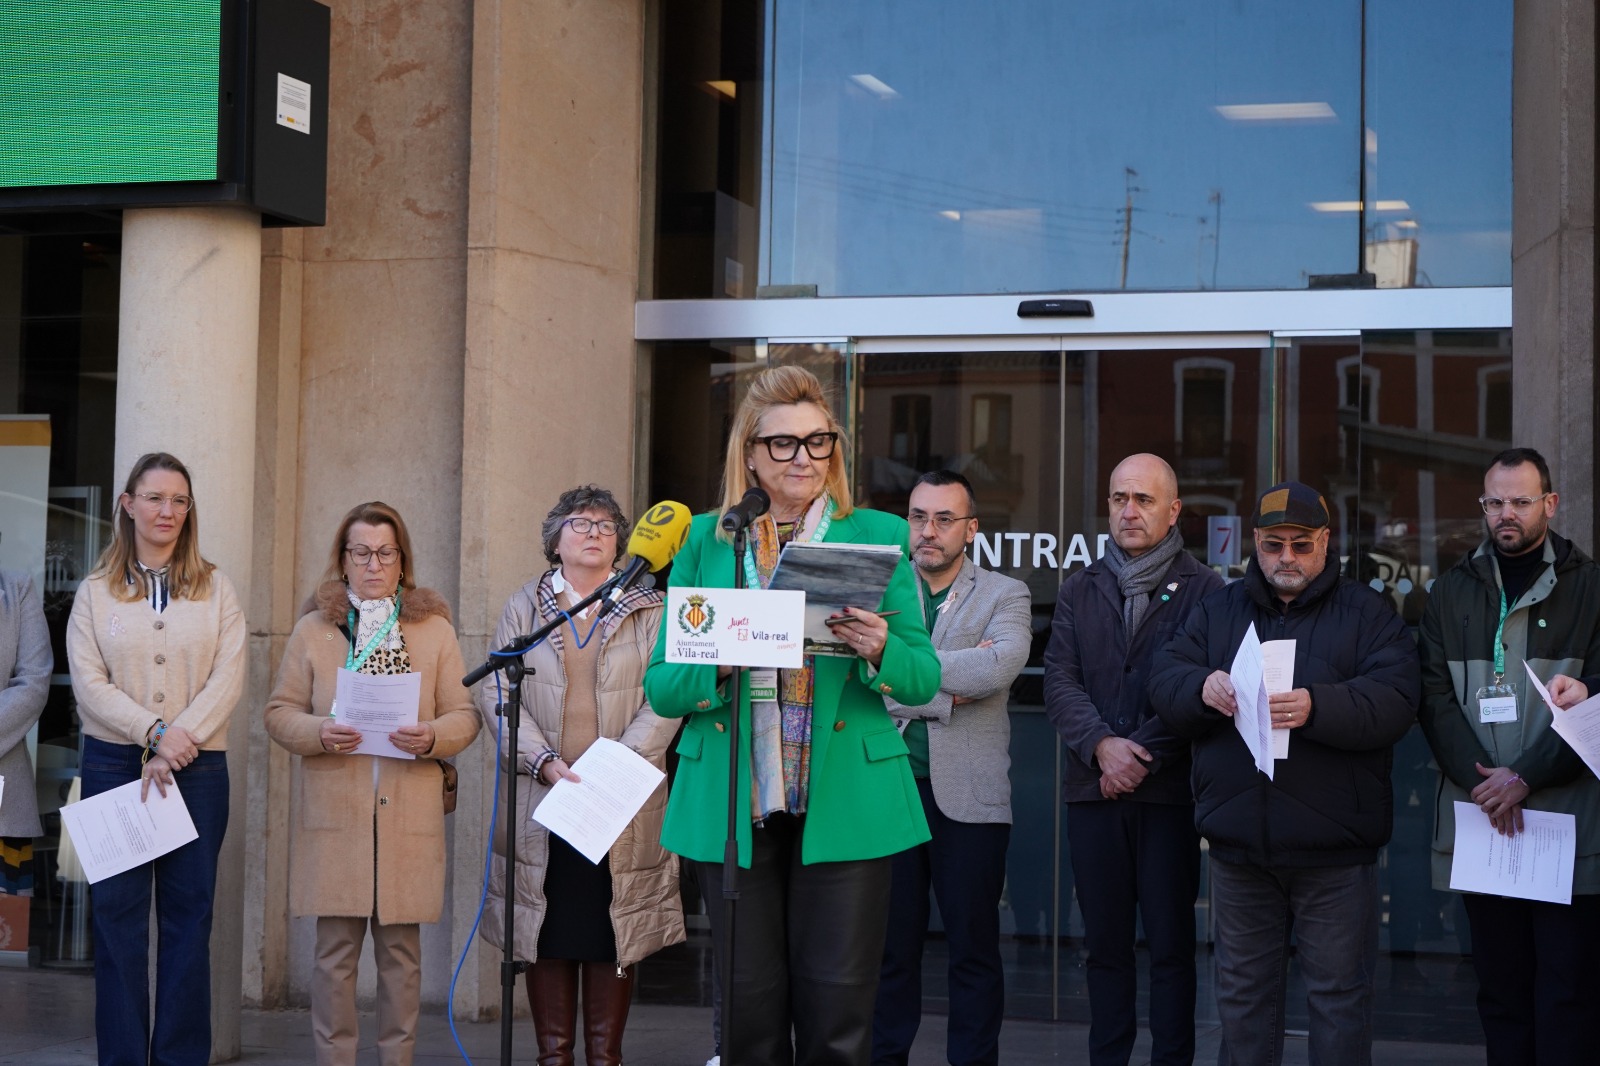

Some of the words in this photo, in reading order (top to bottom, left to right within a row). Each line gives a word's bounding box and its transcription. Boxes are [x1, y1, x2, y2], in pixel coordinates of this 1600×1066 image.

[1216, 527, 1232, 554] 7
[963, 532, 1109, 569] NTRA
[752, 630, 789, 641] Vila-real
[676, 640, 716, 648] Ajuntament
[677, 648, 719, 659] Vila-real
